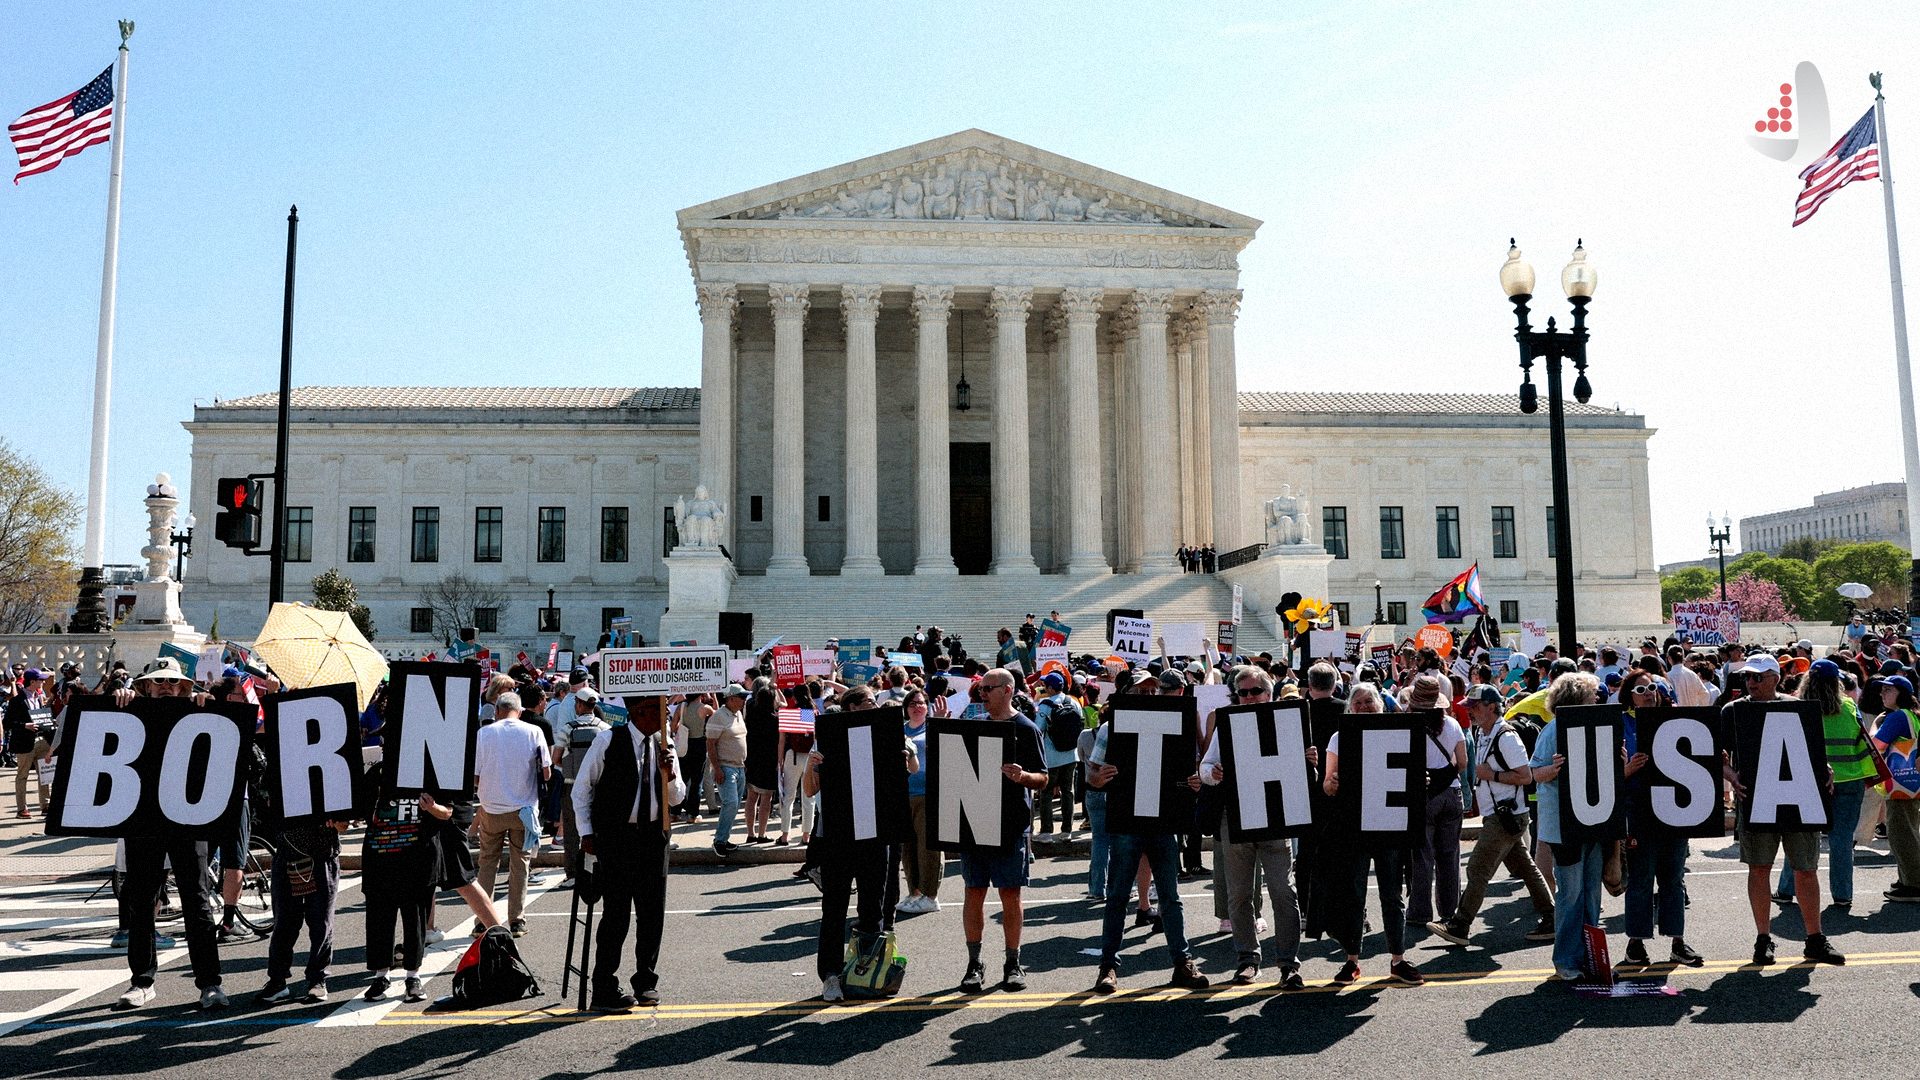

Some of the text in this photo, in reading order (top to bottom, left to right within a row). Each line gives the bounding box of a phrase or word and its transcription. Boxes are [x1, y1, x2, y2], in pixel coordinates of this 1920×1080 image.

[1118, 620, 1128, 628] My
[1118, 630, 1150, 638] Welcomes
[1115, 639, 1148, 654] ALL
[609, 656, 722, 672] STOP HATING EACH OTHER
[776, 654, 800, 664] BIRTH
[777, 664, 802, 674] RIGHT
[608, 672, 710, 685] BECAUSE YOU DISAGREE...
[670, 684, 721, 693] TRUTH CONDUCTOR
